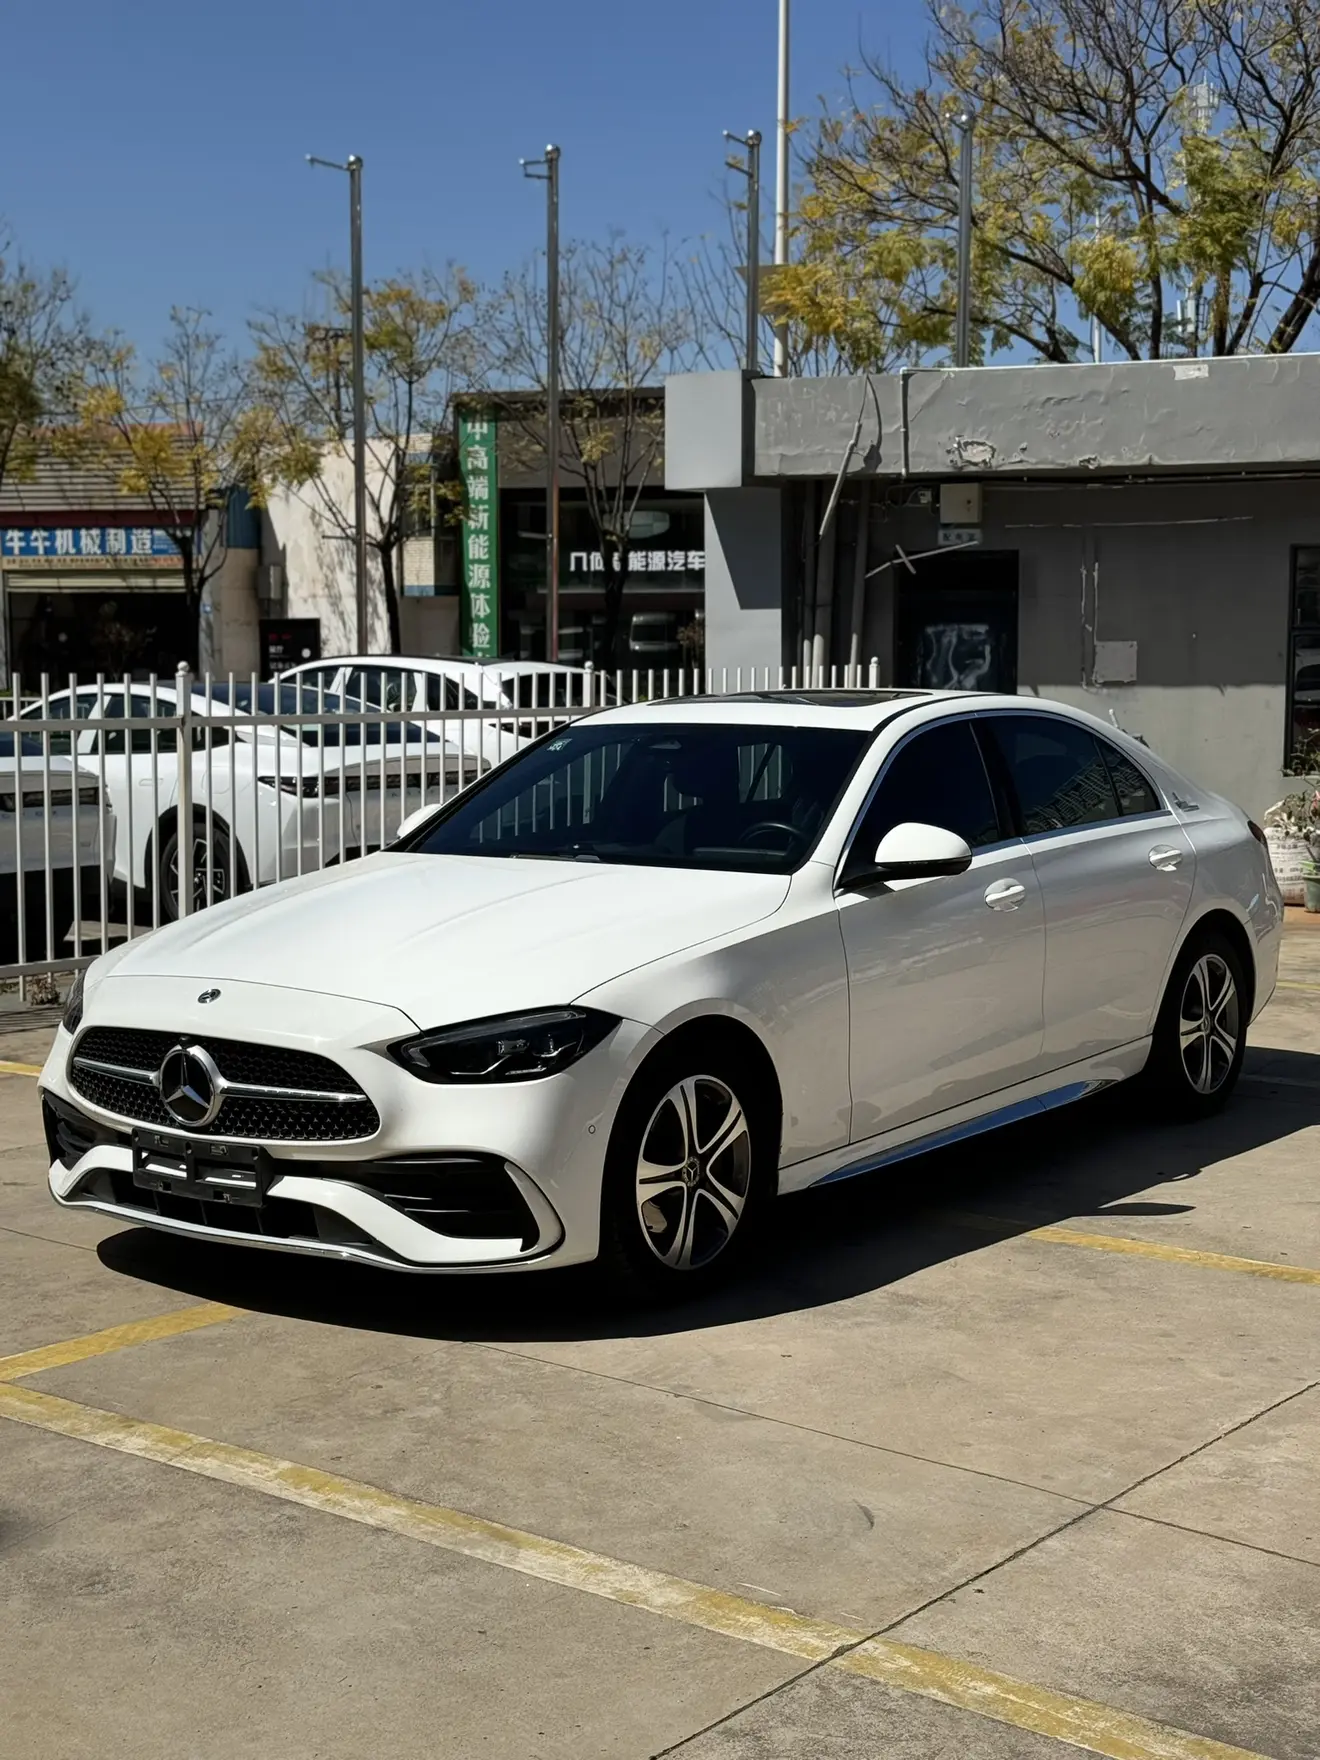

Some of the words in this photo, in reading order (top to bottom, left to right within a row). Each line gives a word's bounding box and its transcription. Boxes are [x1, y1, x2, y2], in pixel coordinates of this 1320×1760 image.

[466, 421, 491, 656] 中高端新能源体验
